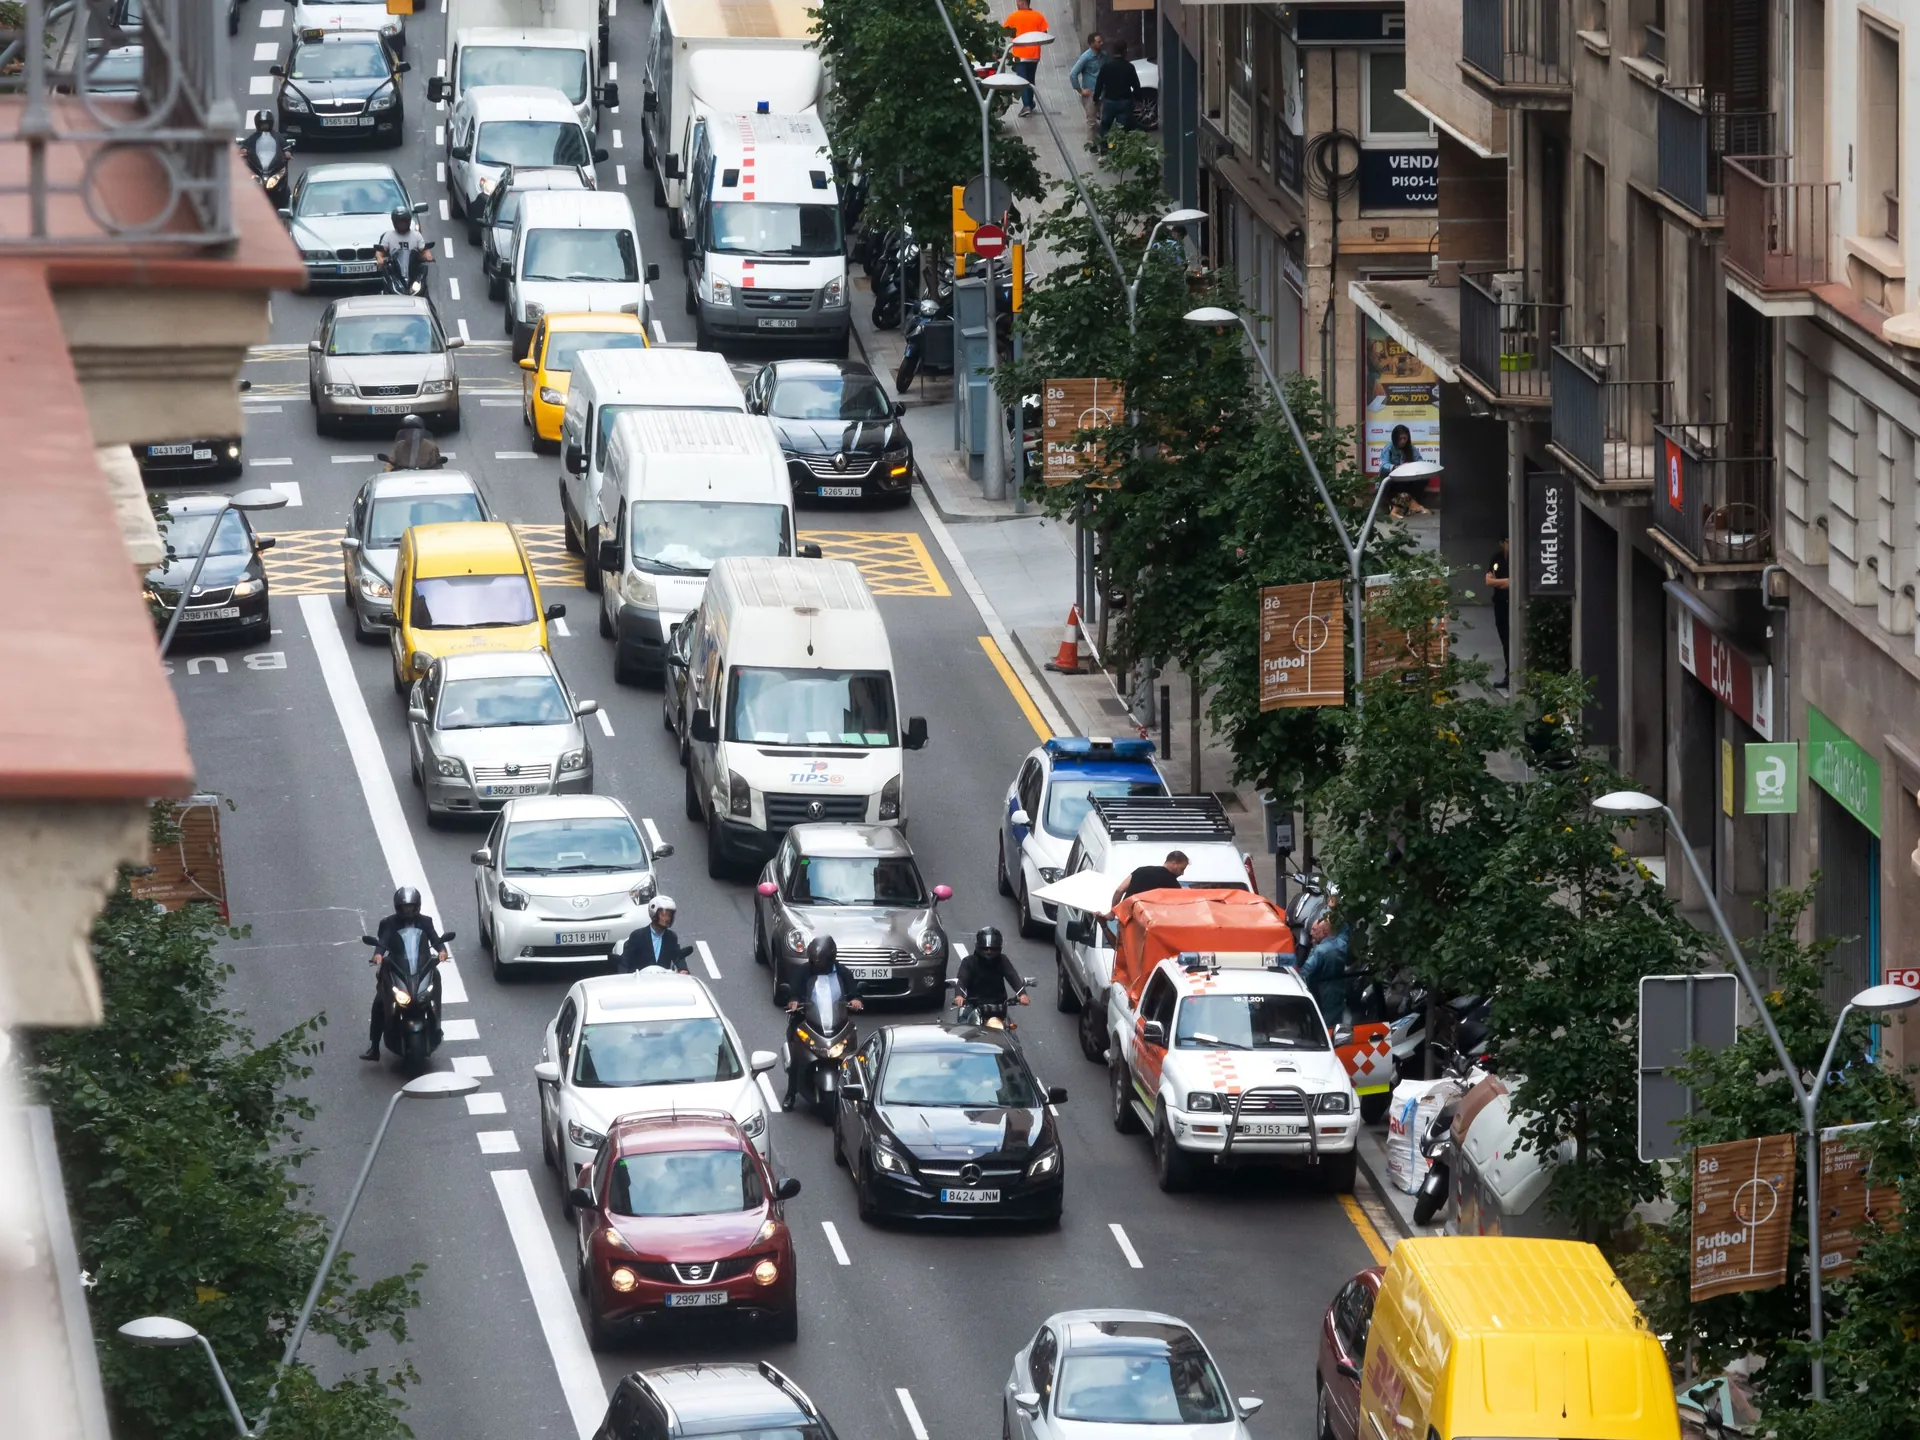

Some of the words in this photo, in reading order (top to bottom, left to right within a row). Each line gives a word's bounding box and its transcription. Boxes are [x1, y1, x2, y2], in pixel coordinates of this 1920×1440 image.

[1391, 176, 1438, 186] PISOS-L
[154, 447, 173, 455] 0431
[196, 450, 209, 459] SP
[1047, 453, 1075, 464] sala
[823, 488, 843, 496] 5265
[845, 488, 860, 496] JXL
[1264, 597, 1281, 610] 8è
[223, 608, 238, 617] SP
[163, 652, 288, 675] BU
[1264, 654, 1305, 671] Futbol
[1711, 634, 1734, 705] ECA
[1264, 670, 1288, 685] sala
[493, 786, 514, 795] 3622
[562, 934, 585, 943] 0318
[588, 932, 607, 942] HHV
[871, 968, 888, 978] HSX
[1888, 970, 1920, 987] FO
[1698, 1157, 1719, 1174] 8è
[1834, 1161, 1853, 1171] 2017
[949, 1190, 975, 1202] 8424
[979, 1190, 999, 1201] JNM
[1696, 1227, 1747, 1252] Futbol
[1696, 1249, 1727, 1268] sala
[675, 1293, 701, 1306] 2997
[705, 1292, 724, 1304] HSF
